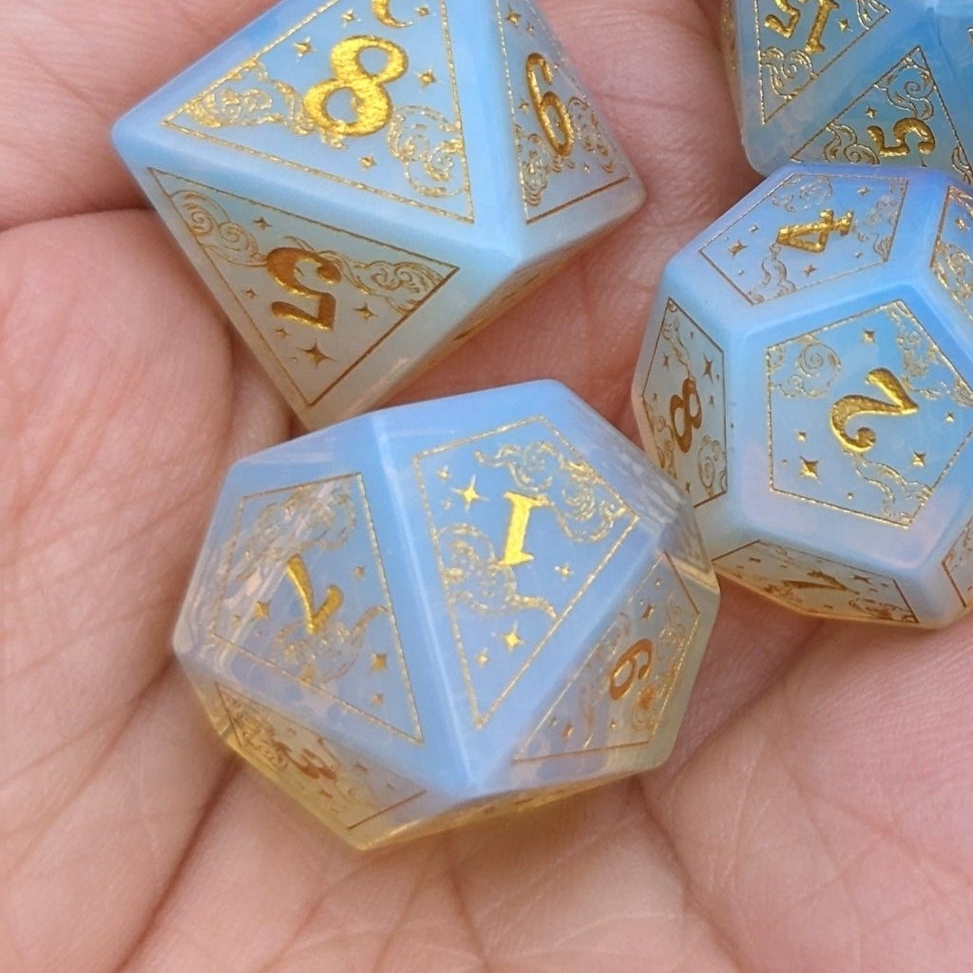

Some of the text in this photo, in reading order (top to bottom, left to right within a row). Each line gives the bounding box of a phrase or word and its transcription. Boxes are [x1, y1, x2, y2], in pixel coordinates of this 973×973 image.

[303, 34, 410, 137] 8
[525, 52, 574, 158] 6
[867, 117, 936, 157] 5
[775, 208, 855, 254] 4
[265, 246, 342, 331] 5
[669, 378, 703, 453] 8
[829, 367, 919, 452] 2
[498, 491, 549, 568] 1
[284, 552, 344, 635] 7
